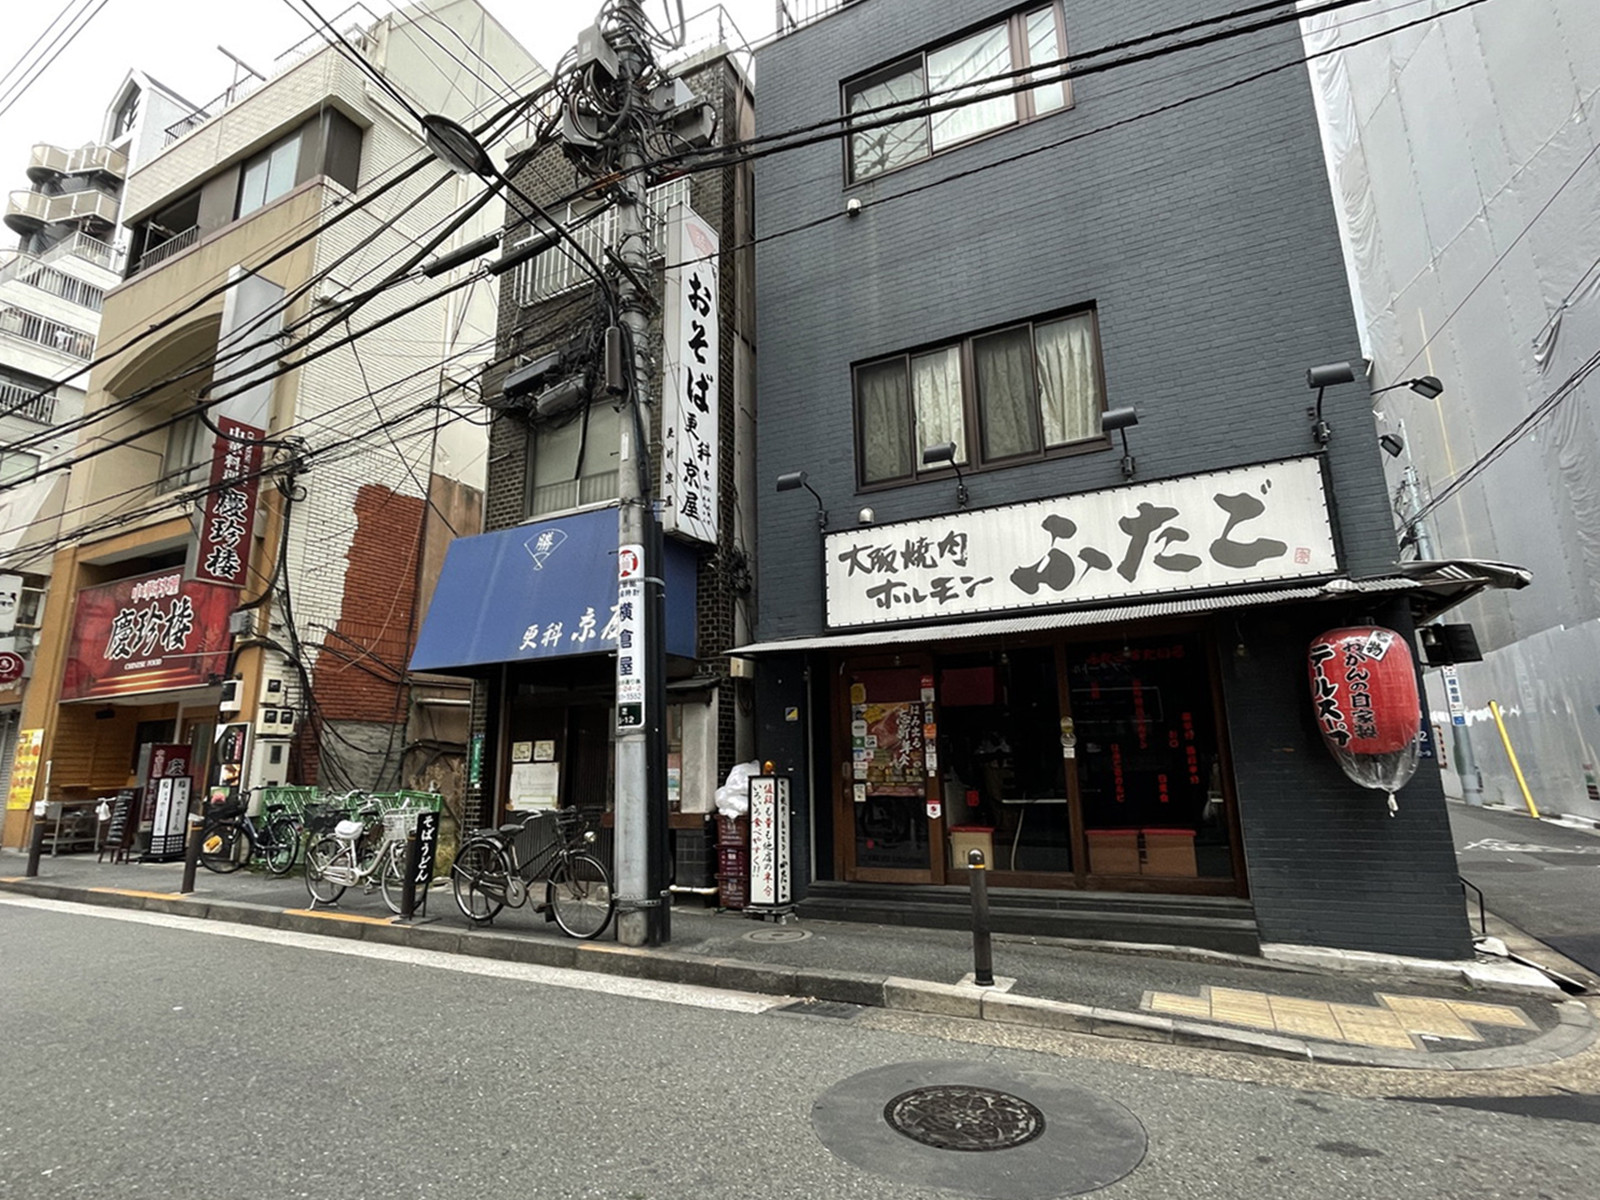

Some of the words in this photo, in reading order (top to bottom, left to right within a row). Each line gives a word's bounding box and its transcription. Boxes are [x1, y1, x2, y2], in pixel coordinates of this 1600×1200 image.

[687, 272, 714, 415] おそば
[838, 530, 969, 576] 大阪焼肉
[1010, 478, 1288, 595] ふたご
[866, 574, 994, 609] ホルモン
[519, 621, 563, 651] 更科
[1310, 642, 1352, 747] テールスープ
[414, 815, 435, 882] そばうどん
